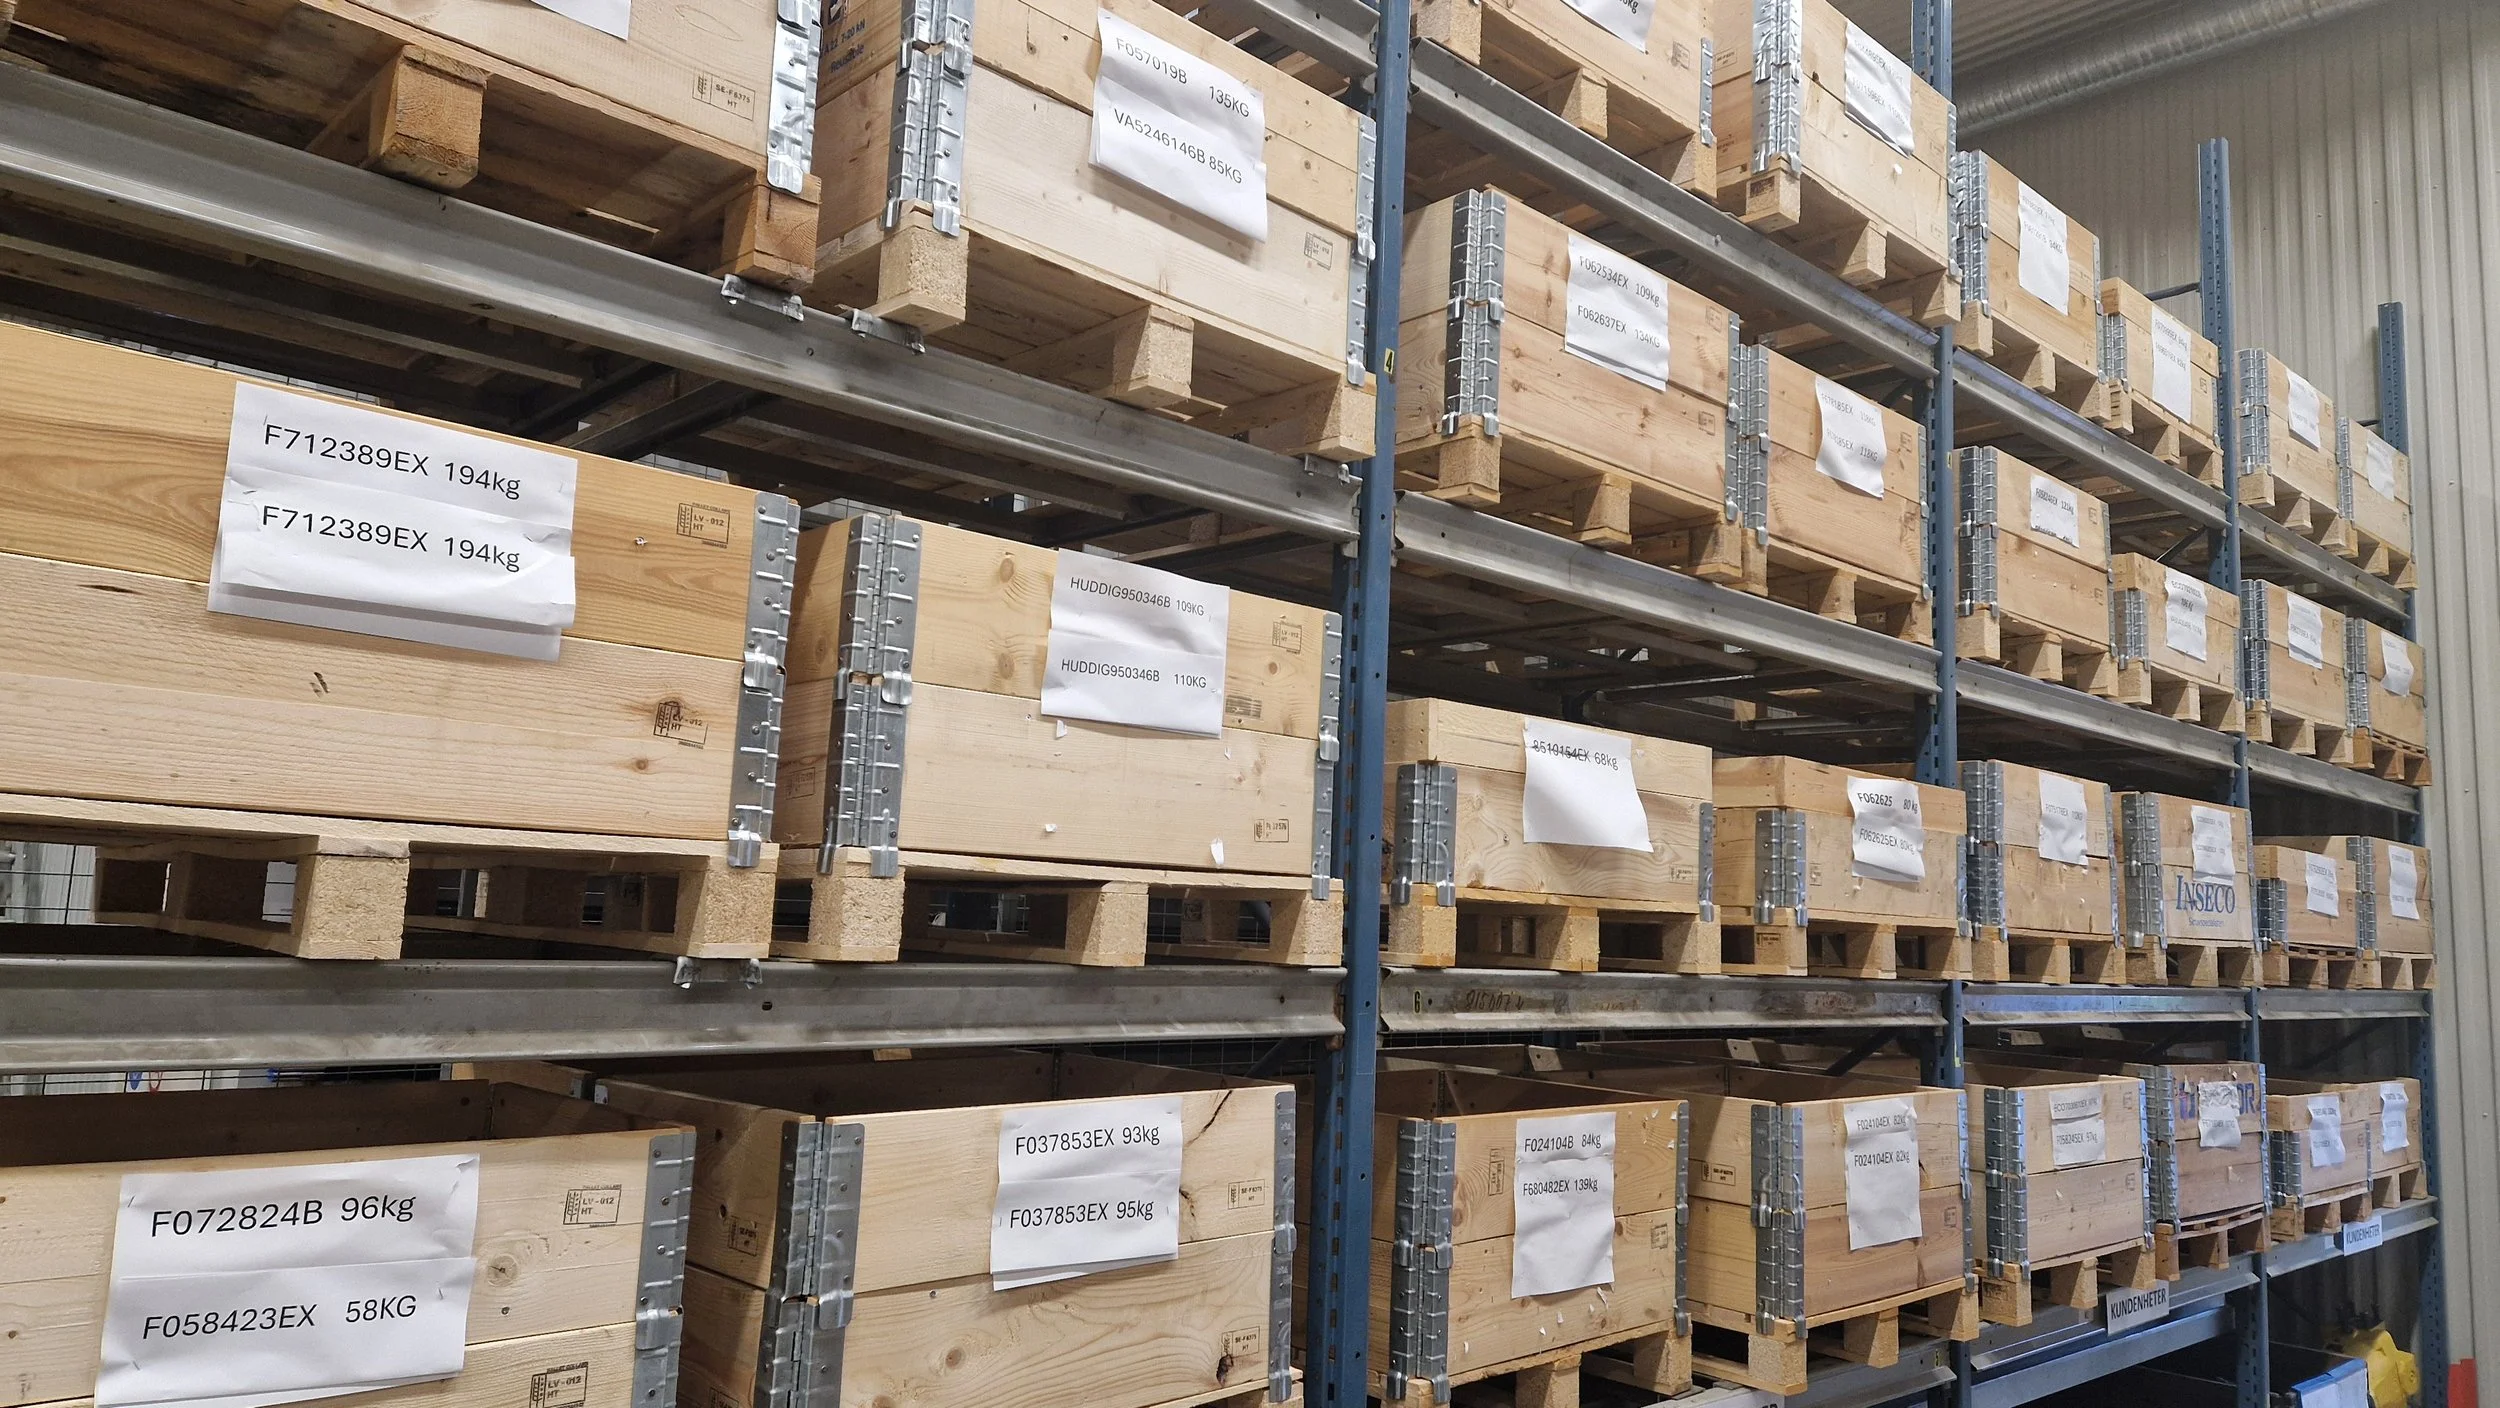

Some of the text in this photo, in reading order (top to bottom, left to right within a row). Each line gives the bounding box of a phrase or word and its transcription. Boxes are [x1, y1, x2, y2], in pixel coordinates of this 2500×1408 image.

[1116, 37, 1250, 118] F057019B 135KG
[1114, 108, 1243, 184] VA5246146B 85KG
[1579, 256, 1660, 308] F062534EX 109kg
[1577, 305, 1660, 348] F062637EX 134KG
[1385, 350, 1393, 373] 4
[264, 424, 521, 501] F712389EX 194kg
[1860, 446, 1878, 462] 118KG
[262, 505, 521, 573] F712389EX 194kg
[692, 522, 704, 532] HT
[1070, 577, 1204, 617] HUDDIG950346B 109KG
[1061, 659, 1207, 689] HUDDIG950346B 110KG
[1594, 752, 1619, 771] 68kg
[1857, 792, 1893, 807] F062625
[1859, 828, 1899, 849] F062625EX
[2176, 874, 2236, 914] INSECO
[1414, 991, 1421, 1013] 6
[1857, 1114, 1907, 1132] F024104EX 82kg
[1015, 1125, 1161, 1156] F037853EX 93kg
[1524, 1133, 1602, 1153] F024104B 84kg
[1854, 1151, 1910, 1167] F024104EX 82kg
[1523, 1177, 1598, 1197] F680482EX 139kg
[151, 1194, 417, 1238] F072824B 96kg
[581, 1207, 593, 1215] HT
[1010, 1200, 1155, 1229] F037853EX 95kg
[142, 1295, 417, 1340] F058423EX 58KG
[2110, 1290, 2168, 1320] KUNDENHETER
[547, 1390, 560, 1399] HT
